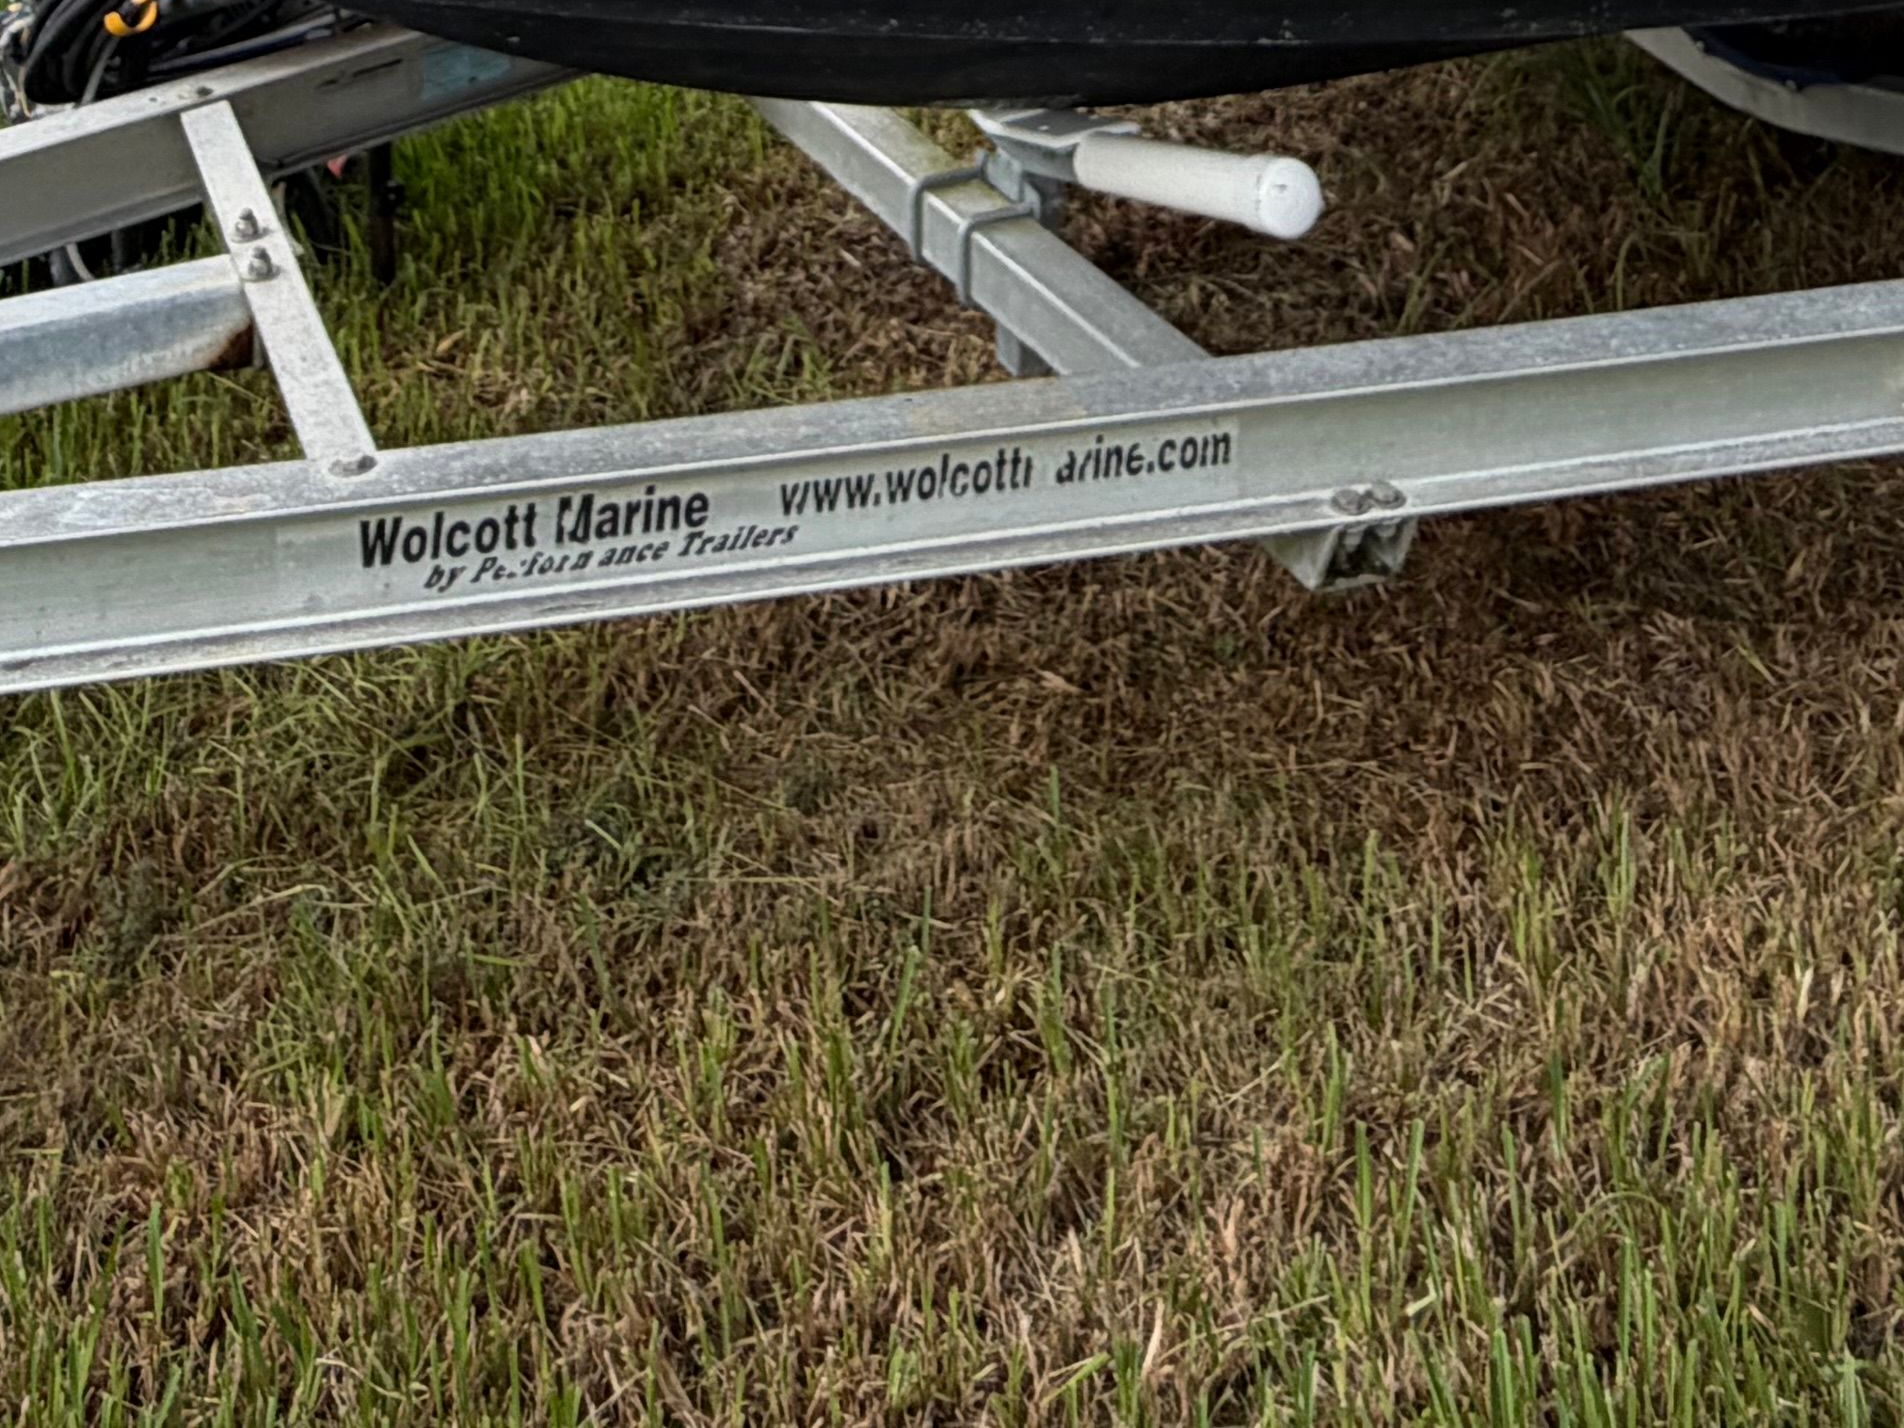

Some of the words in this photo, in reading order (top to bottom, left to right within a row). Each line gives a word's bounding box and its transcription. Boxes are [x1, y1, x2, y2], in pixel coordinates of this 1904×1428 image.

[359, 502, 538, 569] Wolcott
[424, 564, 466, 593] by
[677, 523, 800, 558] Trailers
